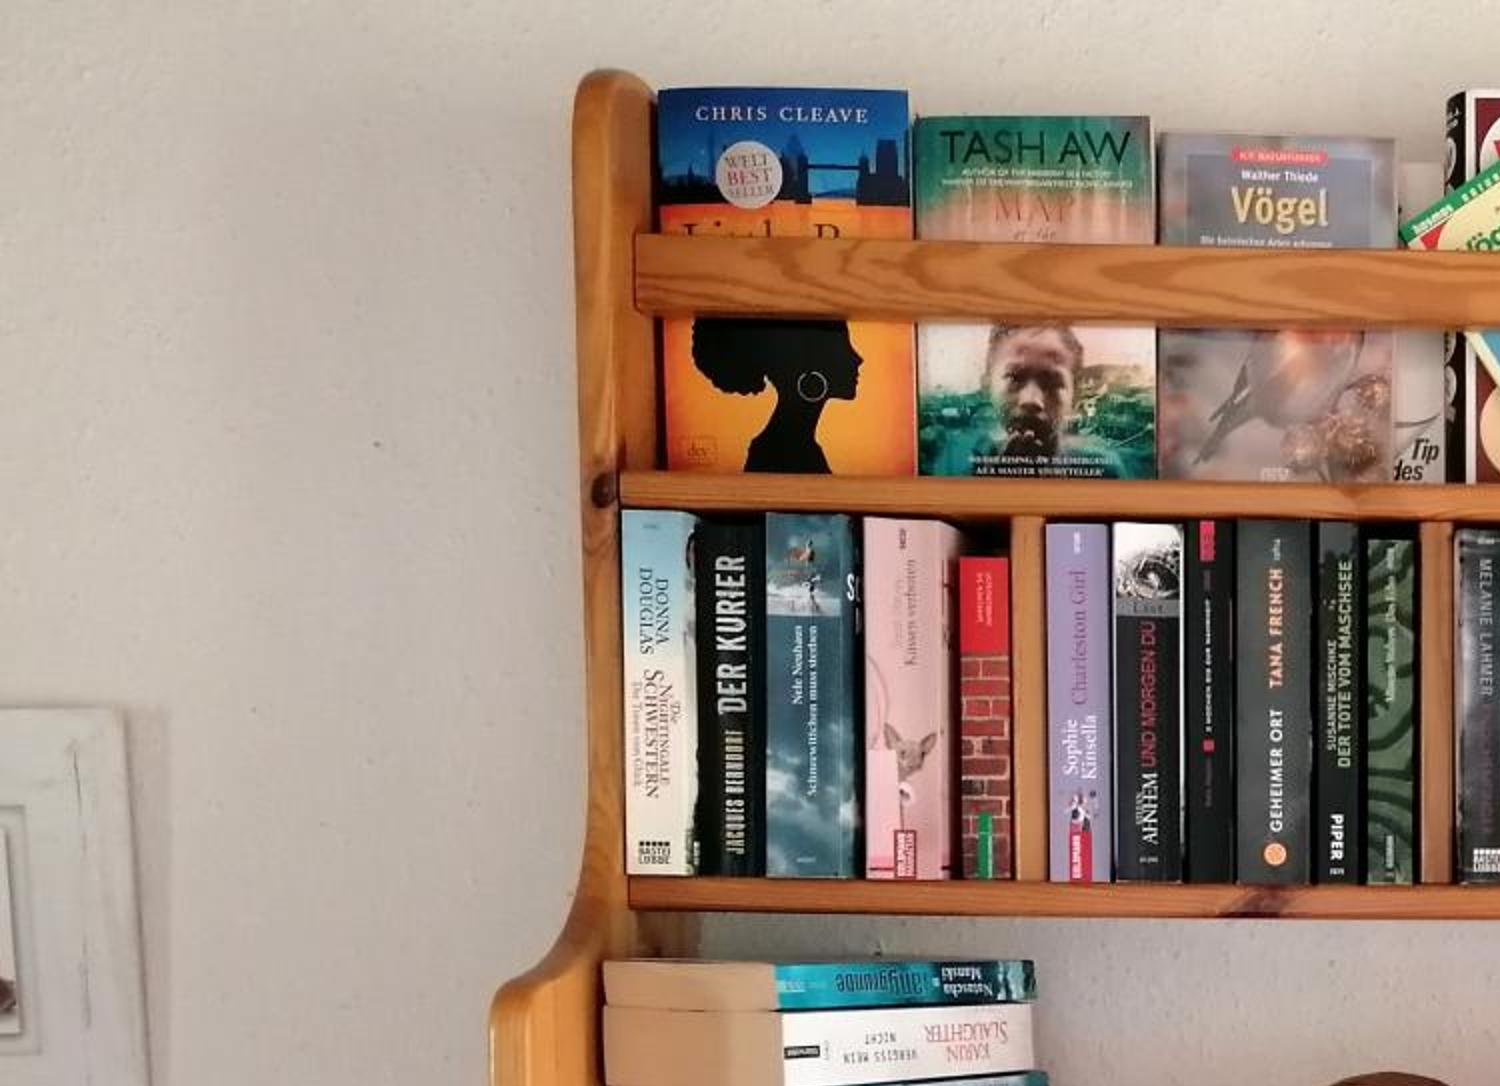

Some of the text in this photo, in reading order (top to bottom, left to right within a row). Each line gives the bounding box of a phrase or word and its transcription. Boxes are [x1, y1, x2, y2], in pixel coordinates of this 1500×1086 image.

[695, 106, 868, 123] CHRIS CLEAVE
[727, 167, 772, 185] BEST
[939, 129, 1131, 165] TASH AW
[1241, 170, 1319, 183] Walther Thiede
[1231, 186, 1329, 235] Vögel
[1411, 438, 1440, 464] Tip
[639, 567, 653, 655] DOUGLAS
[655, 578, 669, 645] DONNA
[1269, 568, 1283, 636] FRENCH
[1479, 558, 1493, 626] MELANIE
[715, 556, 747, 715] DER KURIER
[791, 624, 803, 704] Nele Neuhaus
[1070, 568, 1087, 705] Charleston Girl
[1269, 642, 1283, 689] TANA
[1337, 559, 1352, 768] DER TOTE VOM MASCHSEE
[1479, 633, 1493, 697] LAHMER
[807, 624, 819, 797] Schneewittchen muss sterben
[1140, 621, 1156, 767] UND MORGEN DU
[1326, 639, 1337, 751] SUSANNE MISCHKE
[643, 669, 665, 799] SCHWESTERN
[659, 685, 672, 786] NIGHTINGALE
[1061, 718, 1080, 776] Sophie
[1080, 715, 1098, 780] Kinsella
[1269, 709, 1284, 833] GEHEIMER ORT
[724, 800, 745, 855] JACQUES
[1141, 772, 1159, 845] AHNHEM
[1330, 813, 1345, 861] PIPER
[941, 967, 982, 980] Manski
[943, 983, 993, 998] Natascha
[844, 1050, 918, 1063] VERGISS MEIN
[864, 1032, 897, 1045] NICHT
[924, 1021, 1007, 1043] SLAUGHTER
[947, 1044, 991, 1063] KARIN
